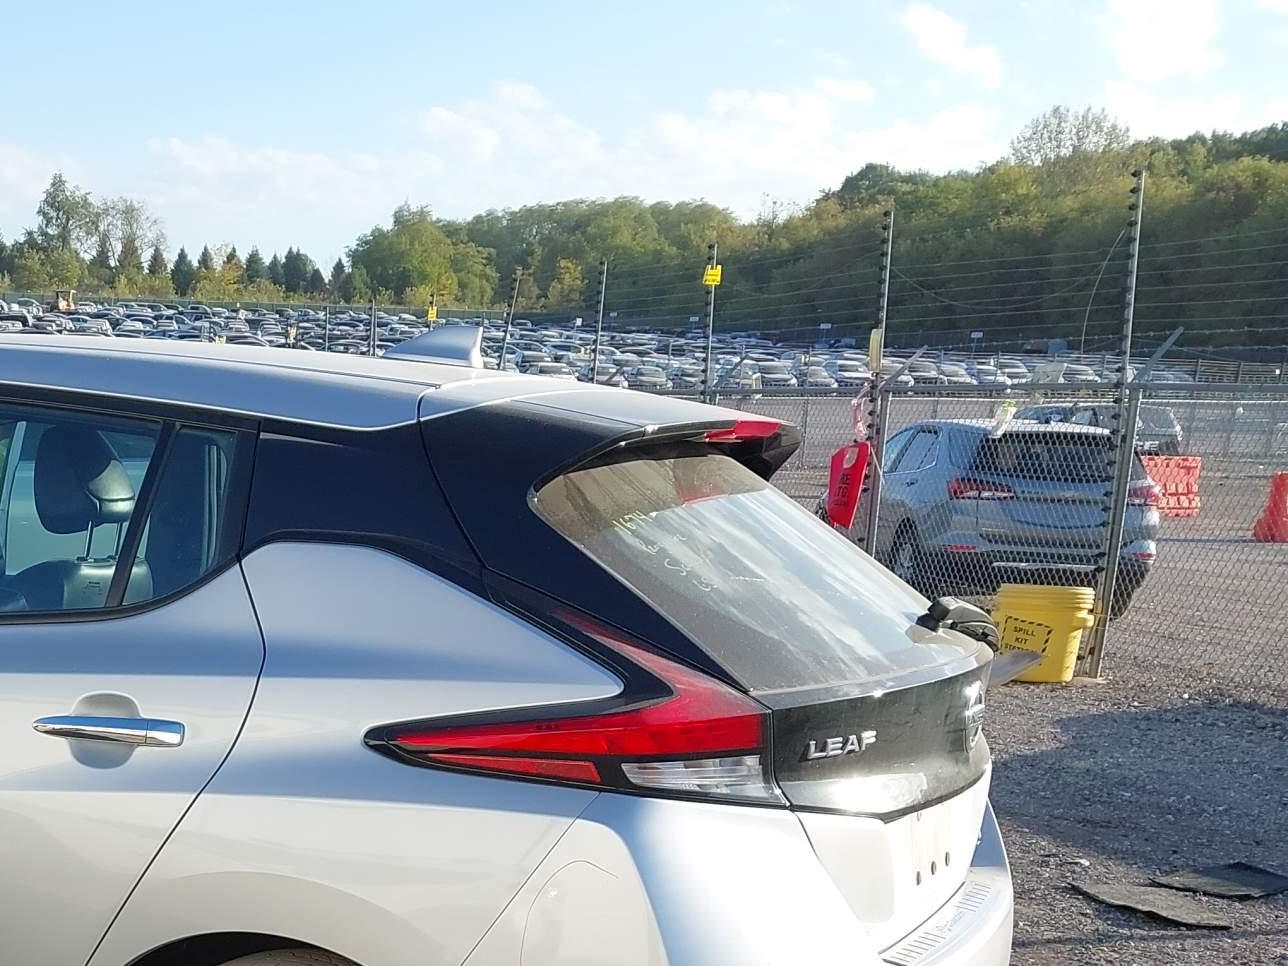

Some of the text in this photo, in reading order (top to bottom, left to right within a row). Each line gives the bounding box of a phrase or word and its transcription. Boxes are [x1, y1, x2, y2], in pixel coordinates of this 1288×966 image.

[1013, 625, 1036, 637] SPILL
[1014, 636, 1029, 645] KIT
[807, 730, 877, 759] LEAF
